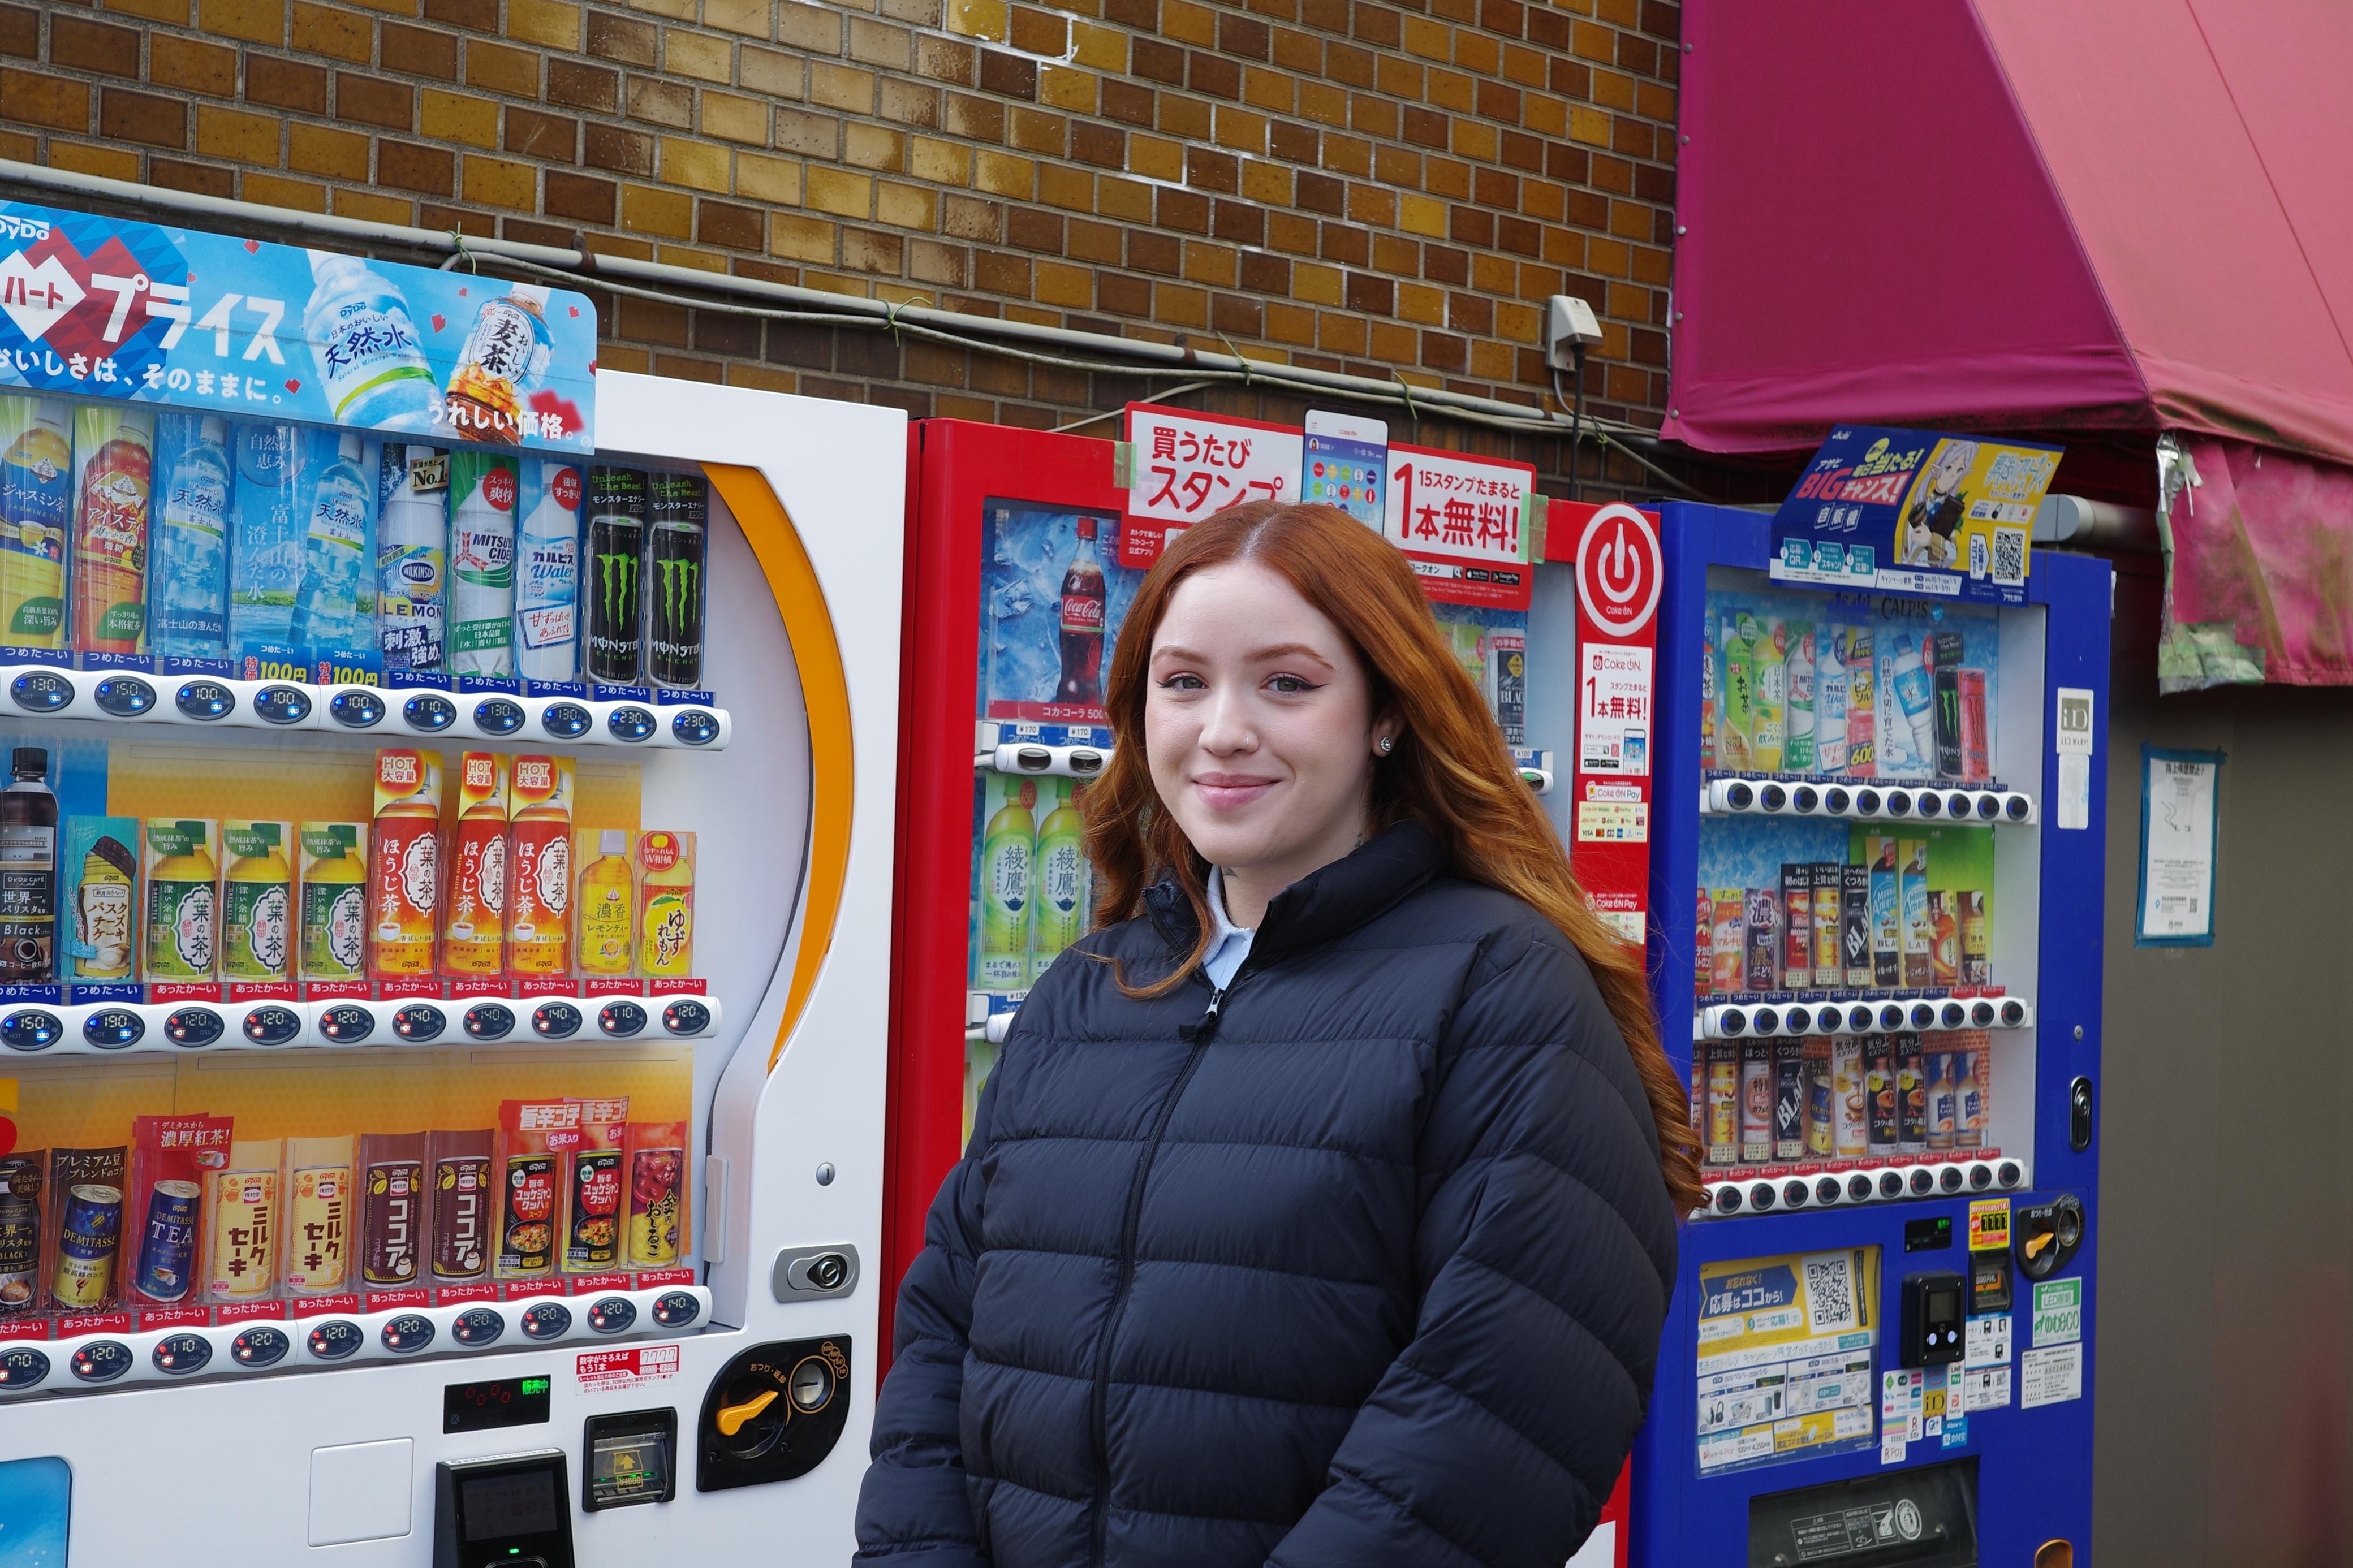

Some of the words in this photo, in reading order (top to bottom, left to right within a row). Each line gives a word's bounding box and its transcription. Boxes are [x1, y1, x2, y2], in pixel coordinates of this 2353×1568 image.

[5, 276, 63, 310] ハート
[339, 302, 367, 317] DyDo
[91, 273, 286, 365] プライス
[331, 314, 389, 339] 日本のおいしい
[325, 323, 412, 379] 天然水
[480, 318, 519, 374] 麦茶
[507, 333, 530, 374] おいしい
[429, 403, 574, 441] うれしい価格。
[251, 434, 291, 452] 自然の
[1152, 426, 1252, 469] 買うたび
[256, 453, 287, 469] 恵み
[488, 476, 514, 487] スッキリ
[563, 477, 578, 487] 後味
[592, 473, 632, 485] Unleash
[600, 482, 619, 491] the
[621, 479, 645, 491] Beast!
[1419, 470, 1520, 500] 15スタンプたまると
[1795, 468, 1854, 500] BIG
[2, 483, 66, 513] ジャスミン茶
[172, 489, 224, 516] 天然水
[489, 488, 513, 504] 爽快
[592, 494, 645, 504] モンスターエナジー
[188, 514, 213, 528] 富士山
[104, 541, 124, 553] 微糖
[246, 525, 268, 601] 澄んだ水
[533, 551, 575, 565] カルピス
[403, 565, 434, 580] WILKINSON
[531, 564, 574, 579] Water
[110, 610, 140, 619] すっきり味の
[383, 604, 442, 618] LEMON
[1064, 598, 1102, 619] Coca-Cola
[1606, 605, 1622, 615] Coke
[24, 615, 57, 627] 深い旨み
[107, 619, 141, 631] 本格紅茶
[158, 619, 222, 633] 富士山の澄んだ水
[528, 611, 571, 628] 甘ずっぱいが
[475, 629, 501, 639] 日本品質
[540, 624, 571, 638] あふれてる
[384, 628, 426, 651] 刺激、
[411, 646, 441, 667] 強め。
[1604, 658, 1626, 670] Coke
[245, 656, 258, 680] 特価
[33, 678, 57, 692] 130
[116, 683, 139, 696] 150
[1610, 682, 1647, 692] スタンプたまると
[420, 701, 442, 713] 110
[1042, 707, 1085, 718] コカ・コーラ
[619, 712, 643, 724] 230
[383, 758, 416, 770] HOT
[1851, 748, 1874, 767] 600
[383, 771, 417, 783] 大容量
[1597, 788, 1615, 798] Coke
[1627, 790, 1640, 801] Pay
[380, 838, 401, 913] ほうじ茶
[1004, 845, 1025, 896] 綾鷹
[88, 902, 128, 913] バスク
[597, 902, 627, 919] 濃香
[93, 914, 127, 928] チーズ
[192, 897, 208, 959] 葉の茶
[587, 923, 630, 934] レモンティー
[4, 926, 41, 935] Black
[93, 928, 126, 941] ケーキ
[667, 909, 686, 956] ゆず
[656, 924, 670, 967] れもん
[20, 1017, 45, 1029] 150
[104, 1015, 128, 1028] 190
[184, 1013, 207, 1026] 120
[520, 1106, 581, 1129] 旨辛ゴチ
[161, 1121, 205, 1130] デミタスから
[161, 1129, 230, 1148] 濃厚紅茶!
[549, 1133, 579, 1147] お米入り
[57, 1153, 121, 1168] プレミアム豆
[515, 1187, 553, 1202] ユッケジャン
[659, 1188, 679, 1225] 金の
[151, 1220, 194, 1244] TEA
[249, 1206, 269, 1266] ミルク
[385, 1199, 408, 1268] ココア
[645, 1199, 662, 1259] おしるこ
[63, 1229, 117, 1249] DEMITASSE
[228, 1227, 250, 1277] セーキ
[1709, 1288, 1783, 1315] 応募はココから!
[579, 1352, 630, 1366] 数字がそろえば
[579, 1363, 607, 1373] もう1本
[751, 1363, 787, 1385] おつり・返却
[522, 1379, 549, 1396] 販売中
[1925, 1394, 1945, 1411] iD
